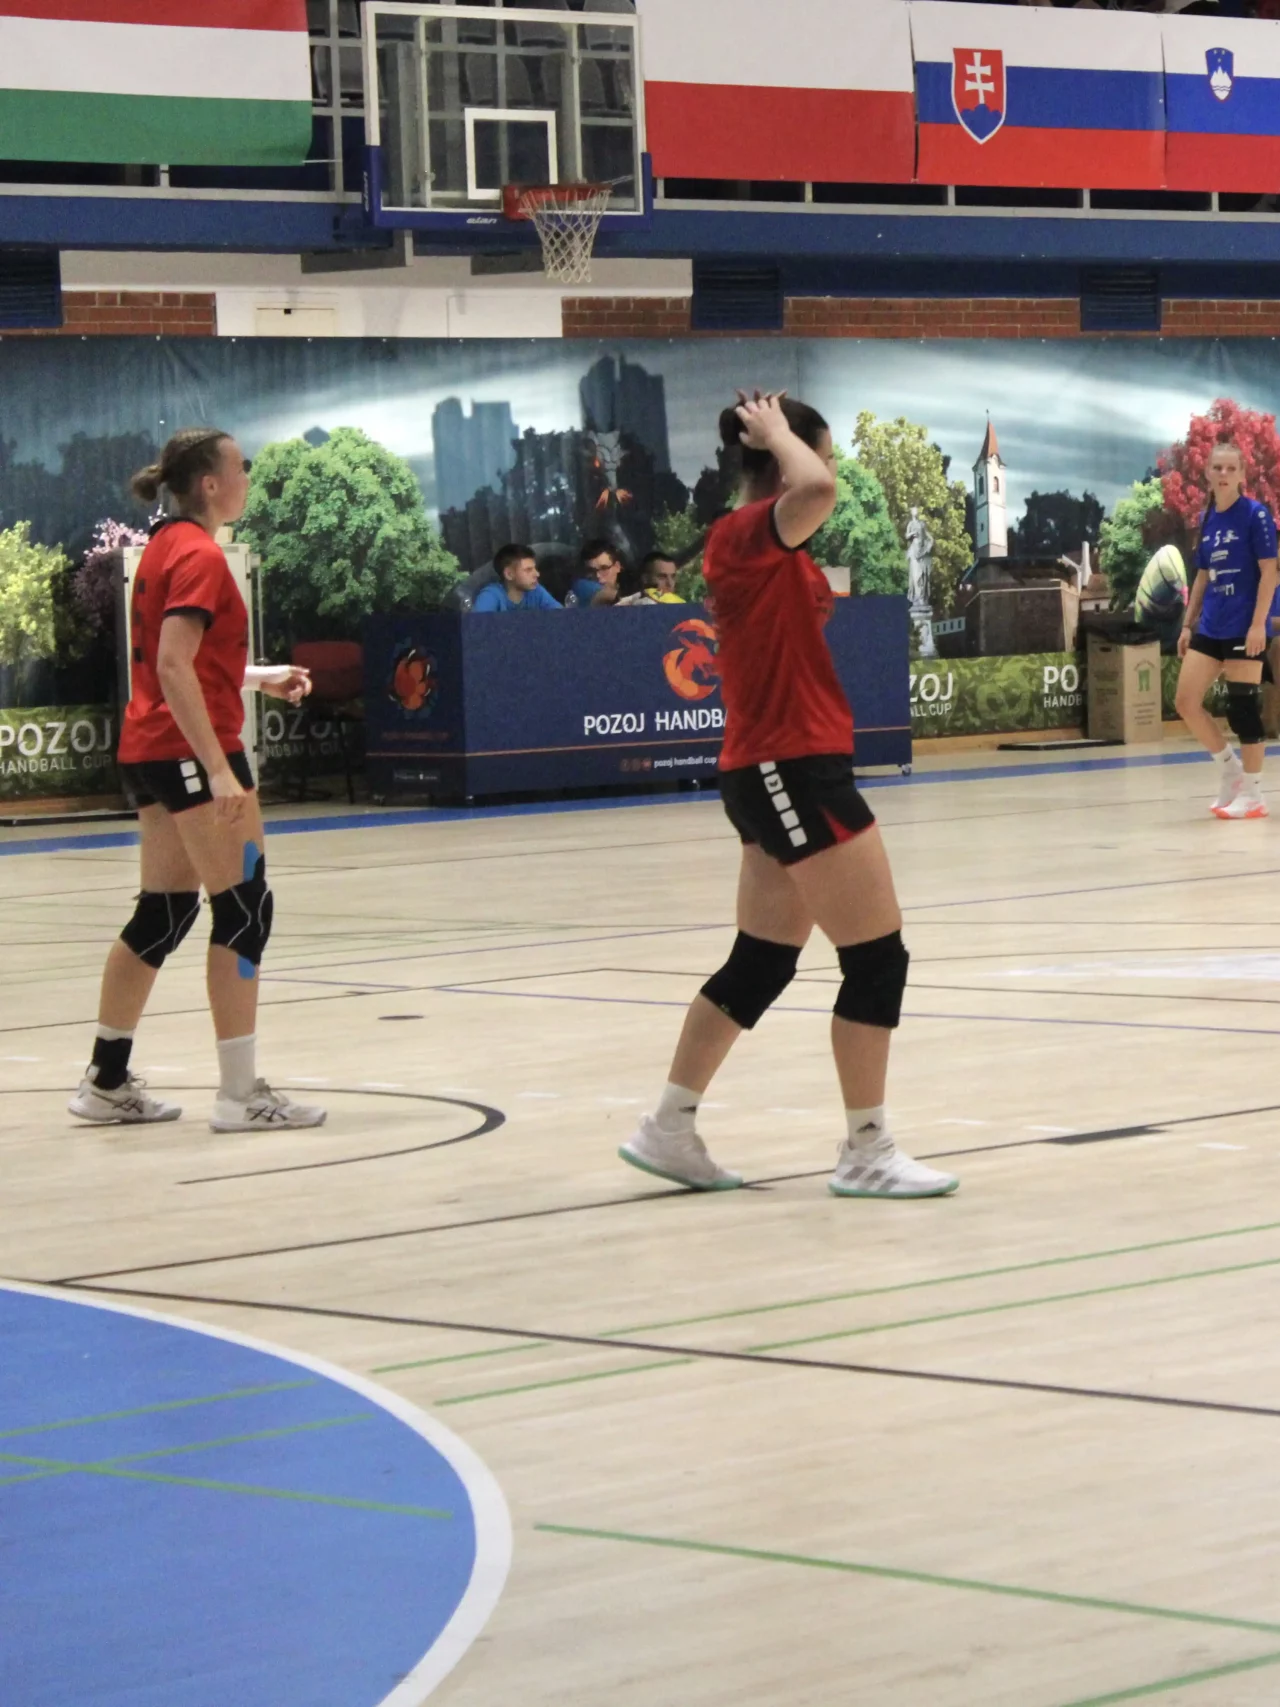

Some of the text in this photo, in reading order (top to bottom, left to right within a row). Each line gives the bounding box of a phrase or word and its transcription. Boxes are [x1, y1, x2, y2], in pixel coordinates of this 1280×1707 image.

[928, 703, 952, 717] CUP
[583, 708, 728, 736] POZOJ HANDB
[0, 718, 112, 758] POZOJ
[0, 757, 77, 775] HANDBALL
[653, 755, 717, 769] pozoj handball cup
